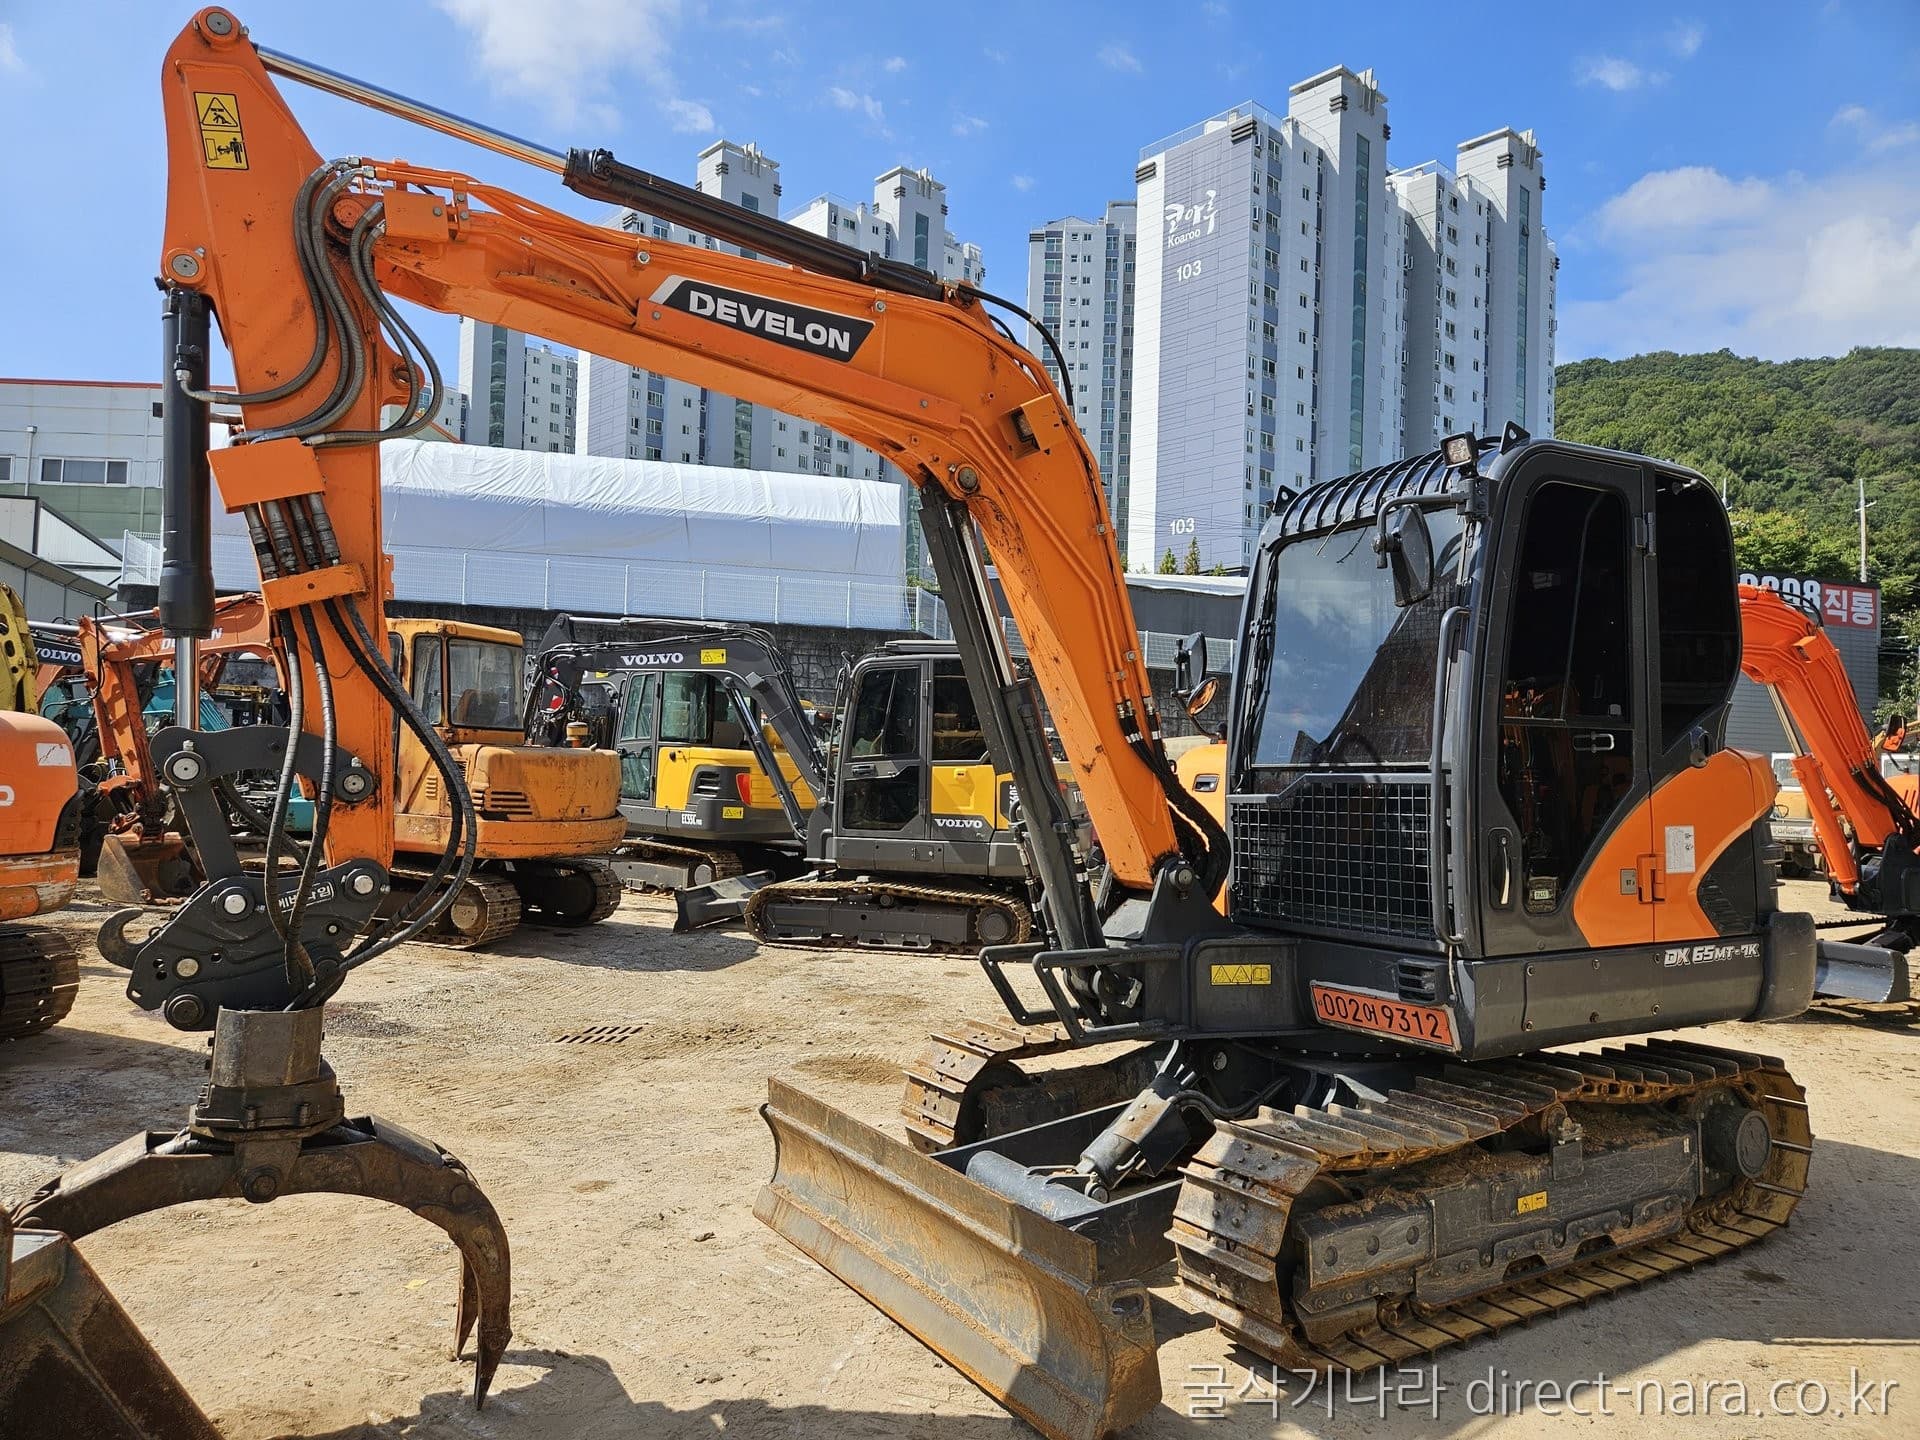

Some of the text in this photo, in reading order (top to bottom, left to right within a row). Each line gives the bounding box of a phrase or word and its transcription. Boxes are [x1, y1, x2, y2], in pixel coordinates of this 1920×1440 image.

[1167, 228, 1201, 249] Koaroo
[1176, 259, 1202, 282] 103
[688, 289, 851, 353] DEVELON
[1169, 517, 1195, 535] 103
[1824, 588, 1874, 625] 직통
[620, 652, 684, 666] VOLVO
[934, 818, 983, 829] VOLVO
[1664, 947, 1691, 967] DX
